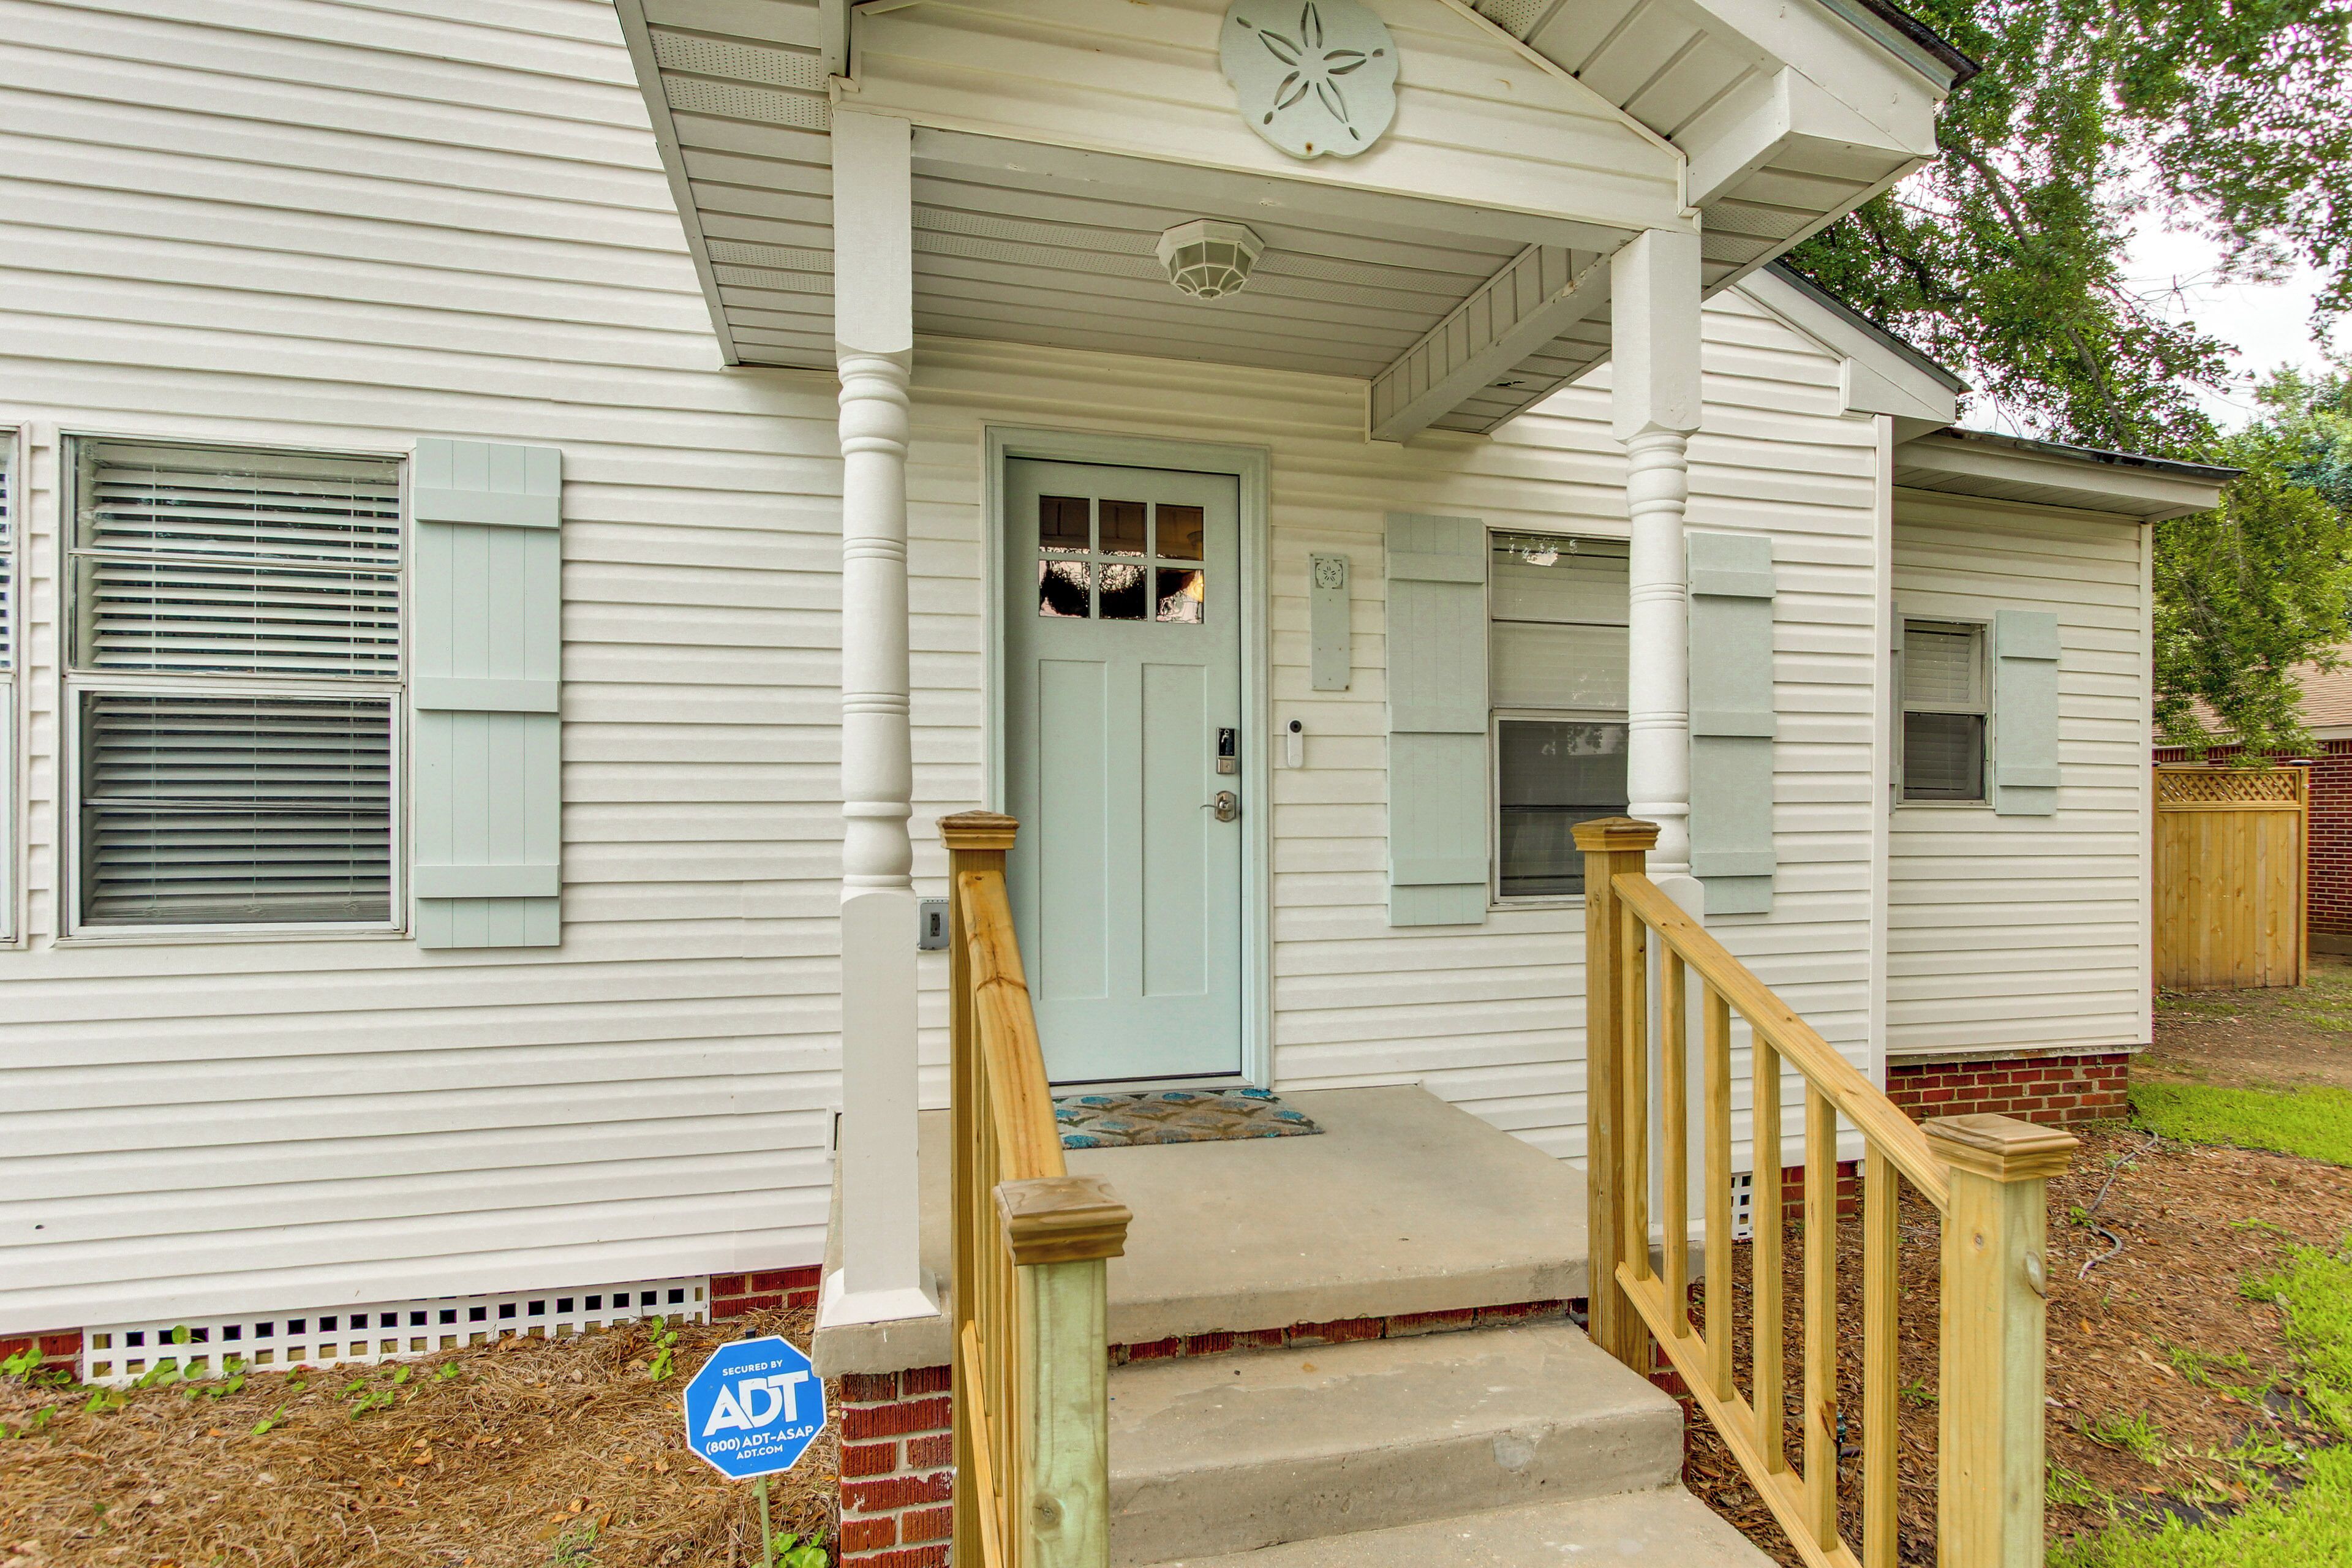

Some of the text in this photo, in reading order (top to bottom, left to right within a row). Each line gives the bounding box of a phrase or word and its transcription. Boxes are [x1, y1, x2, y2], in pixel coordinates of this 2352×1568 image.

[722, 1362, 768, 1376] SECURED
[702, 1370, 809, 1437] ADT
[706, 1425, 814, 1455] (800) ADT-ASAP
[736, 1444, 783, 1460] ADT.COM
